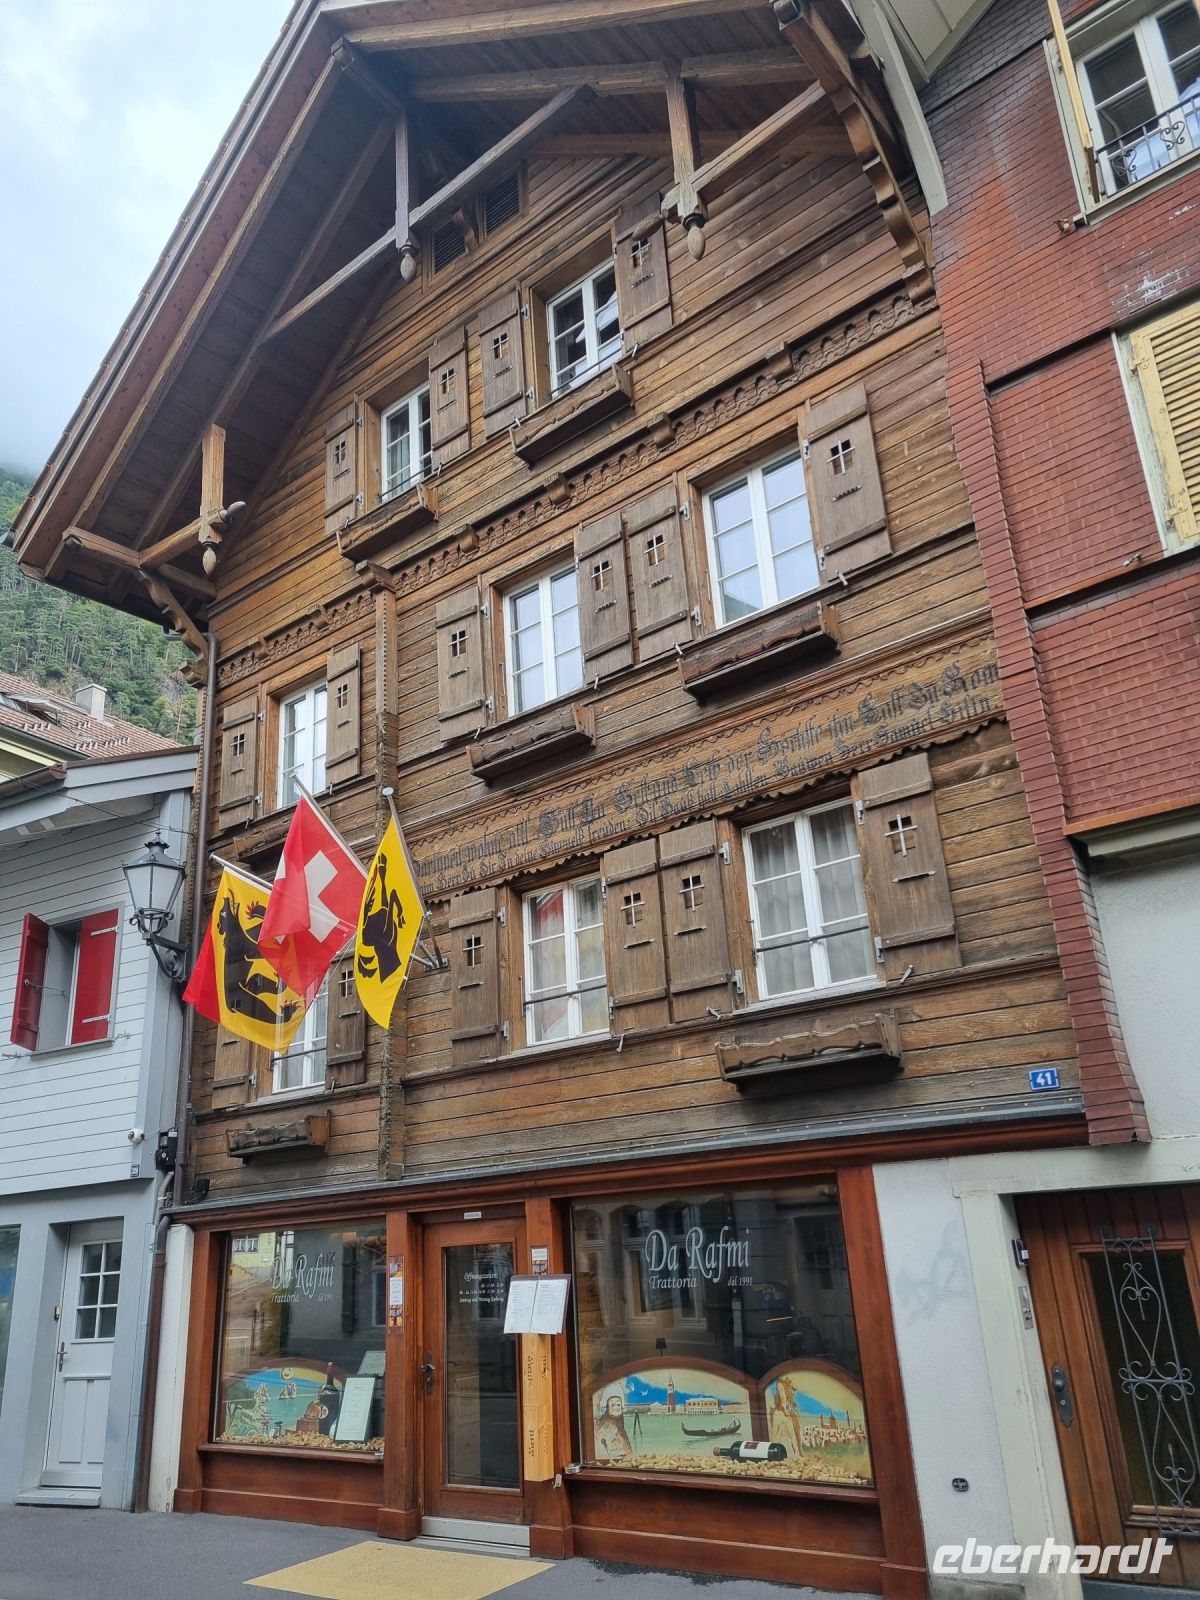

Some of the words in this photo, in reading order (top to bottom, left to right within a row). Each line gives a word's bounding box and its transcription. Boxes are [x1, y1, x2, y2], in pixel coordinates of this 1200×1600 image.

[1037, 1072, 1052, 1086] 41
[645, 1229, 679, 1271] Da
[686, 1226, 749, 1283] Rafmi
[295, 1254, 335, 1298] Rafmi
[649, 1274, 697, 1289] Trattoria
[728, 1276, 737, 1286] dal
[739, 1276, 752, 1286] 1991
[271, 1292, 299, 1303] Trattoria
